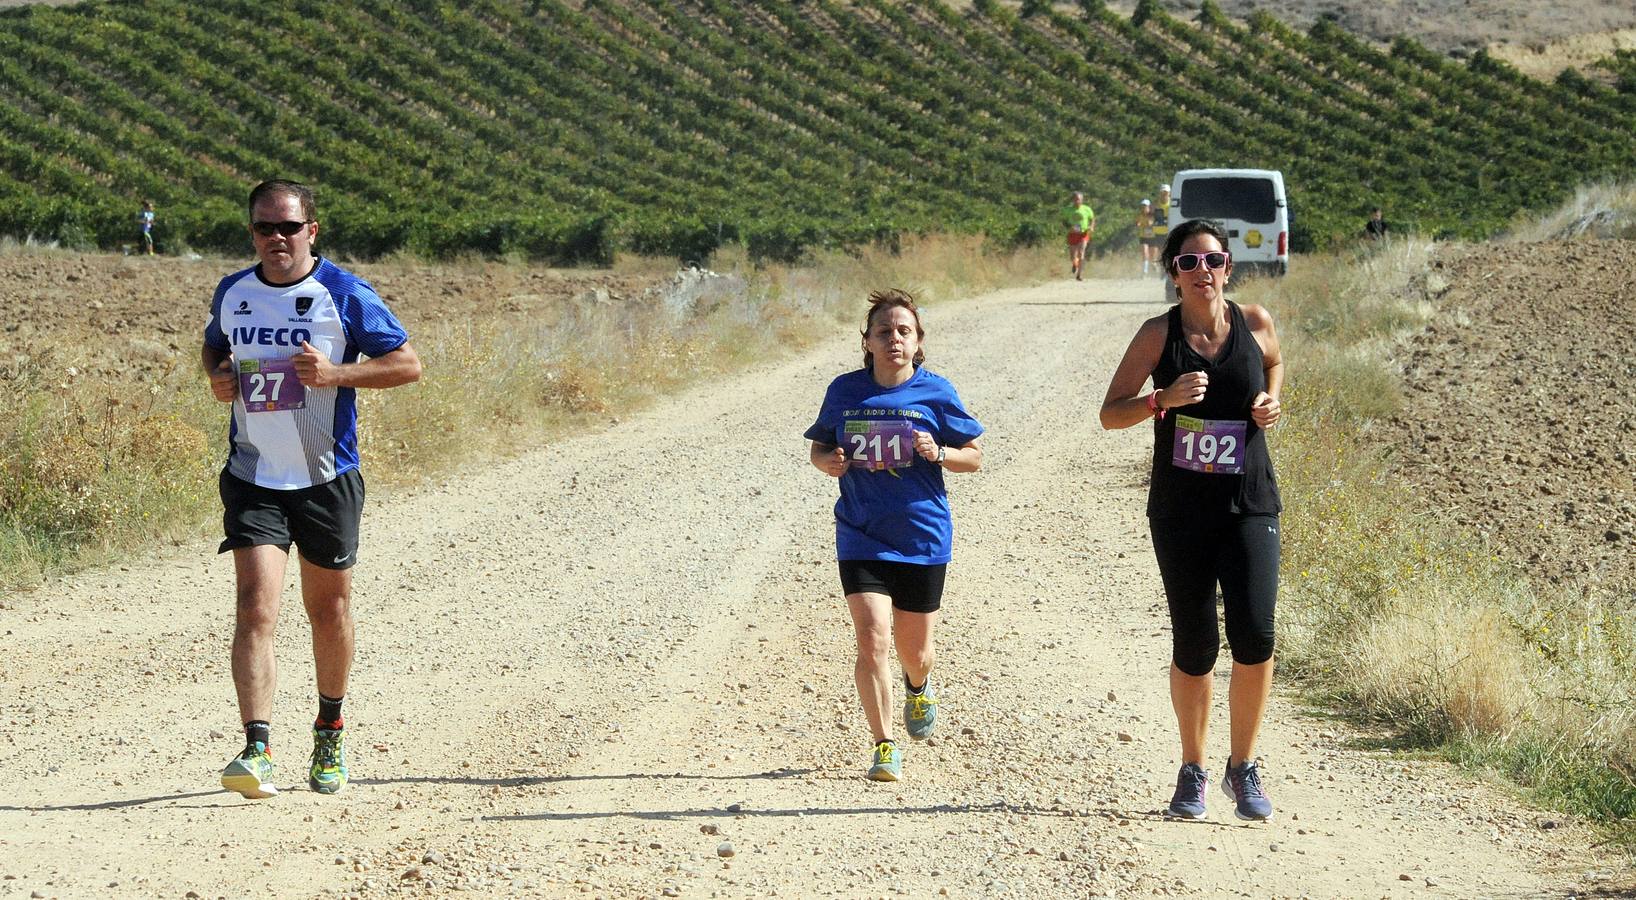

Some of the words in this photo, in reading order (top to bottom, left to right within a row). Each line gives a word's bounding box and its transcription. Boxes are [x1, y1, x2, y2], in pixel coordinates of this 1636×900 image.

[233, 327, 311, 347] IVECO
[249, 372, 285, 402] 27
[850, 434, 901, 462] 211
[1181, 431, 1237, 465] 192
